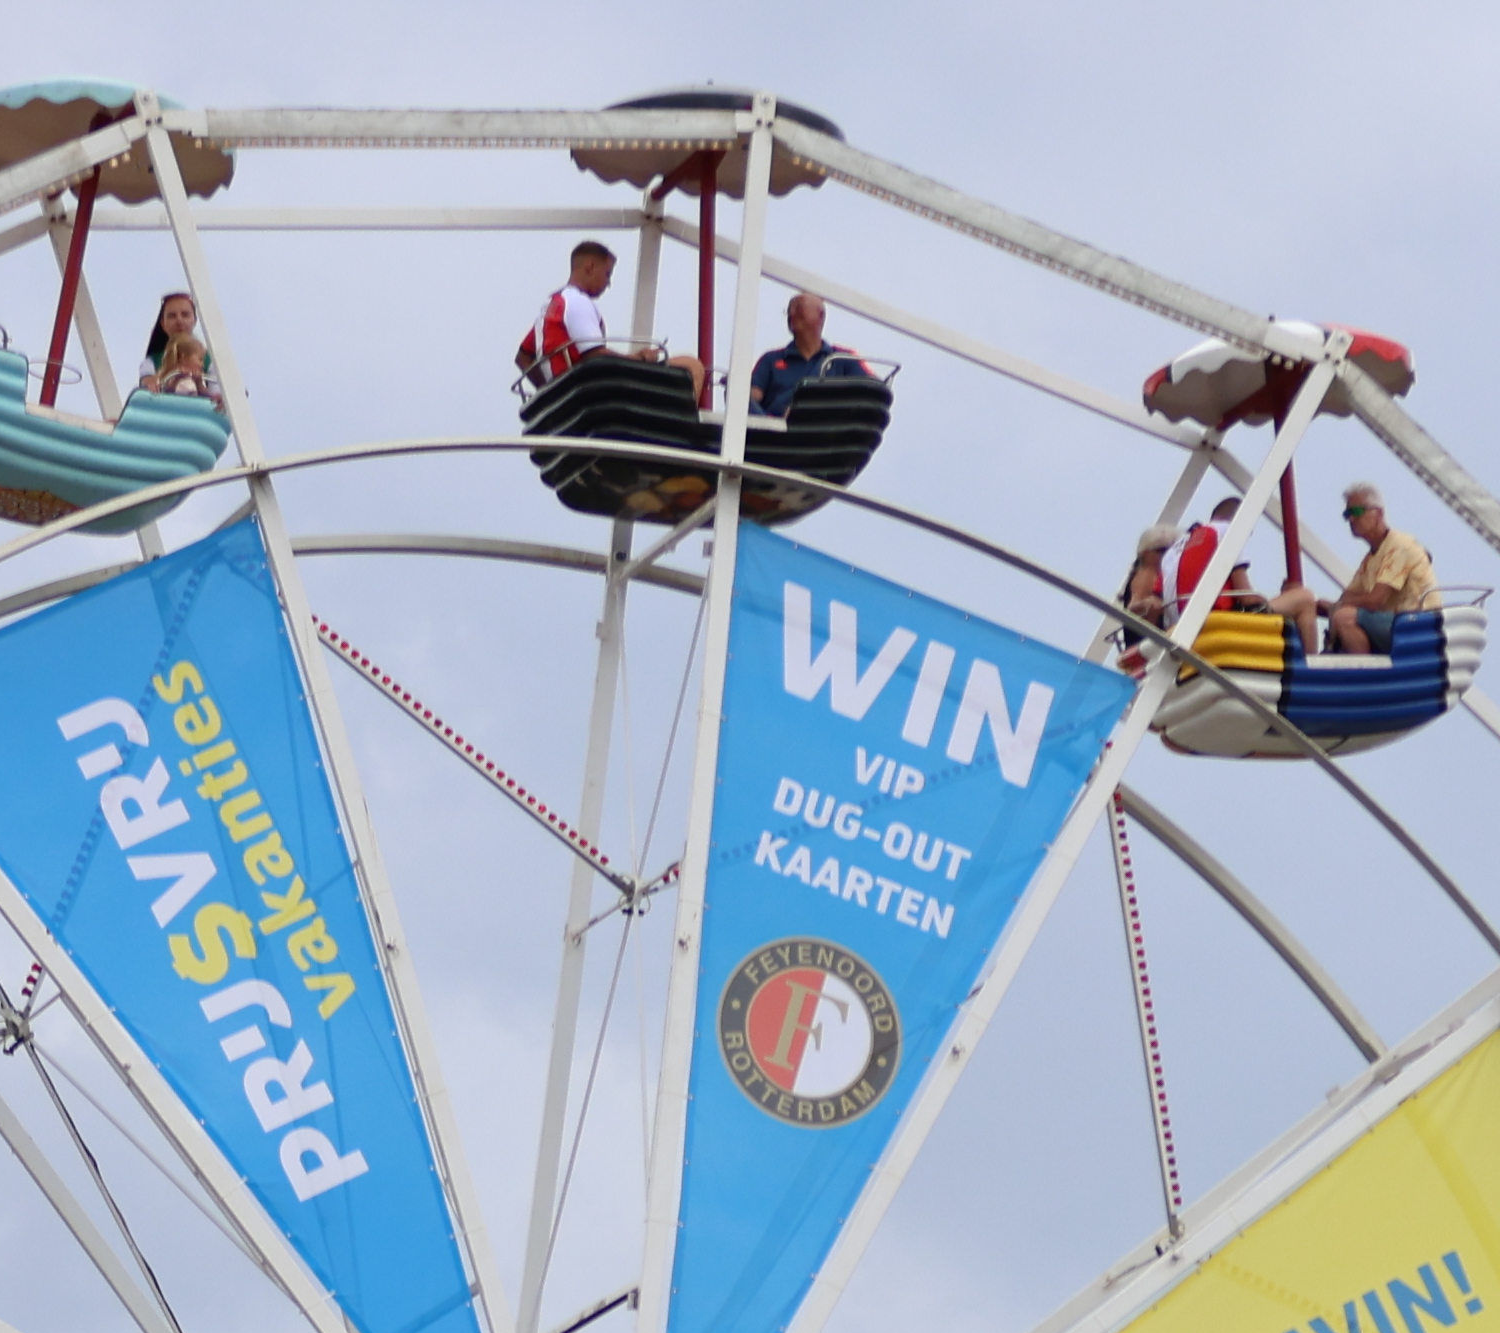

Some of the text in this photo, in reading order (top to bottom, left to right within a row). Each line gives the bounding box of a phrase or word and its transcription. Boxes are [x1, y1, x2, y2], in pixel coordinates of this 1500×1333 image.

[784, 581, 1055, 788] WIN
[856, 746, 925, 798] VIP
[152, 659, 357, 1018] vakanties
[773, 777, 973, 881] DUG-OUT
[754, 831, 955, 938] KAARTEN
[744, 941, 894, 1036] FEYENOORD
[724, 1031, 876, 1123] ROTTERDAM
